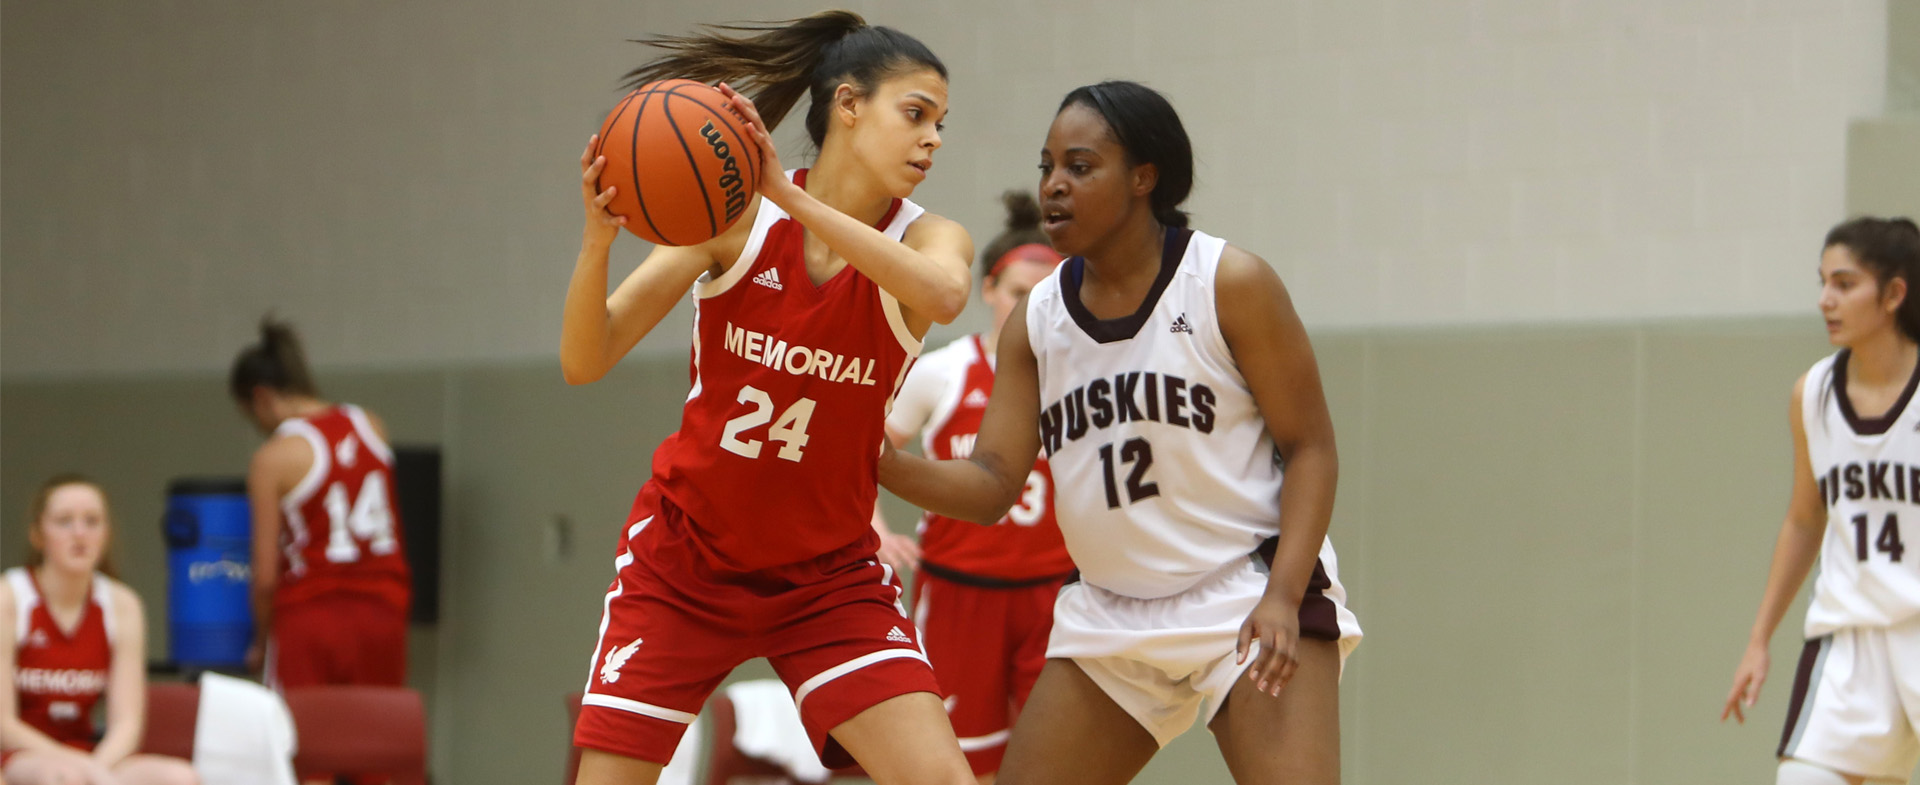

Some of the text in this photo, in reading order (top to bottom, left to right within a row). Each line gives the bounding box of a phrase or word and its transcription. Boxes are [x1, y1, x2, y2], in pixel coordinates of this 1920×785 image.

[699, 119, 746, 224] Wilson
[753, 277, 783, 290] adidas
[724, 321, 876, 386] MEMORIAL
[1170, 323, 1193, 335] adids
[719, 384, 817, 463] 24
[1040, 371, 1216, 457] HUSKIES
[1099, 436, 1161, 510] 12
[322, 469, 398, 563] 14
[1851, 512, 1904, 562] 14
